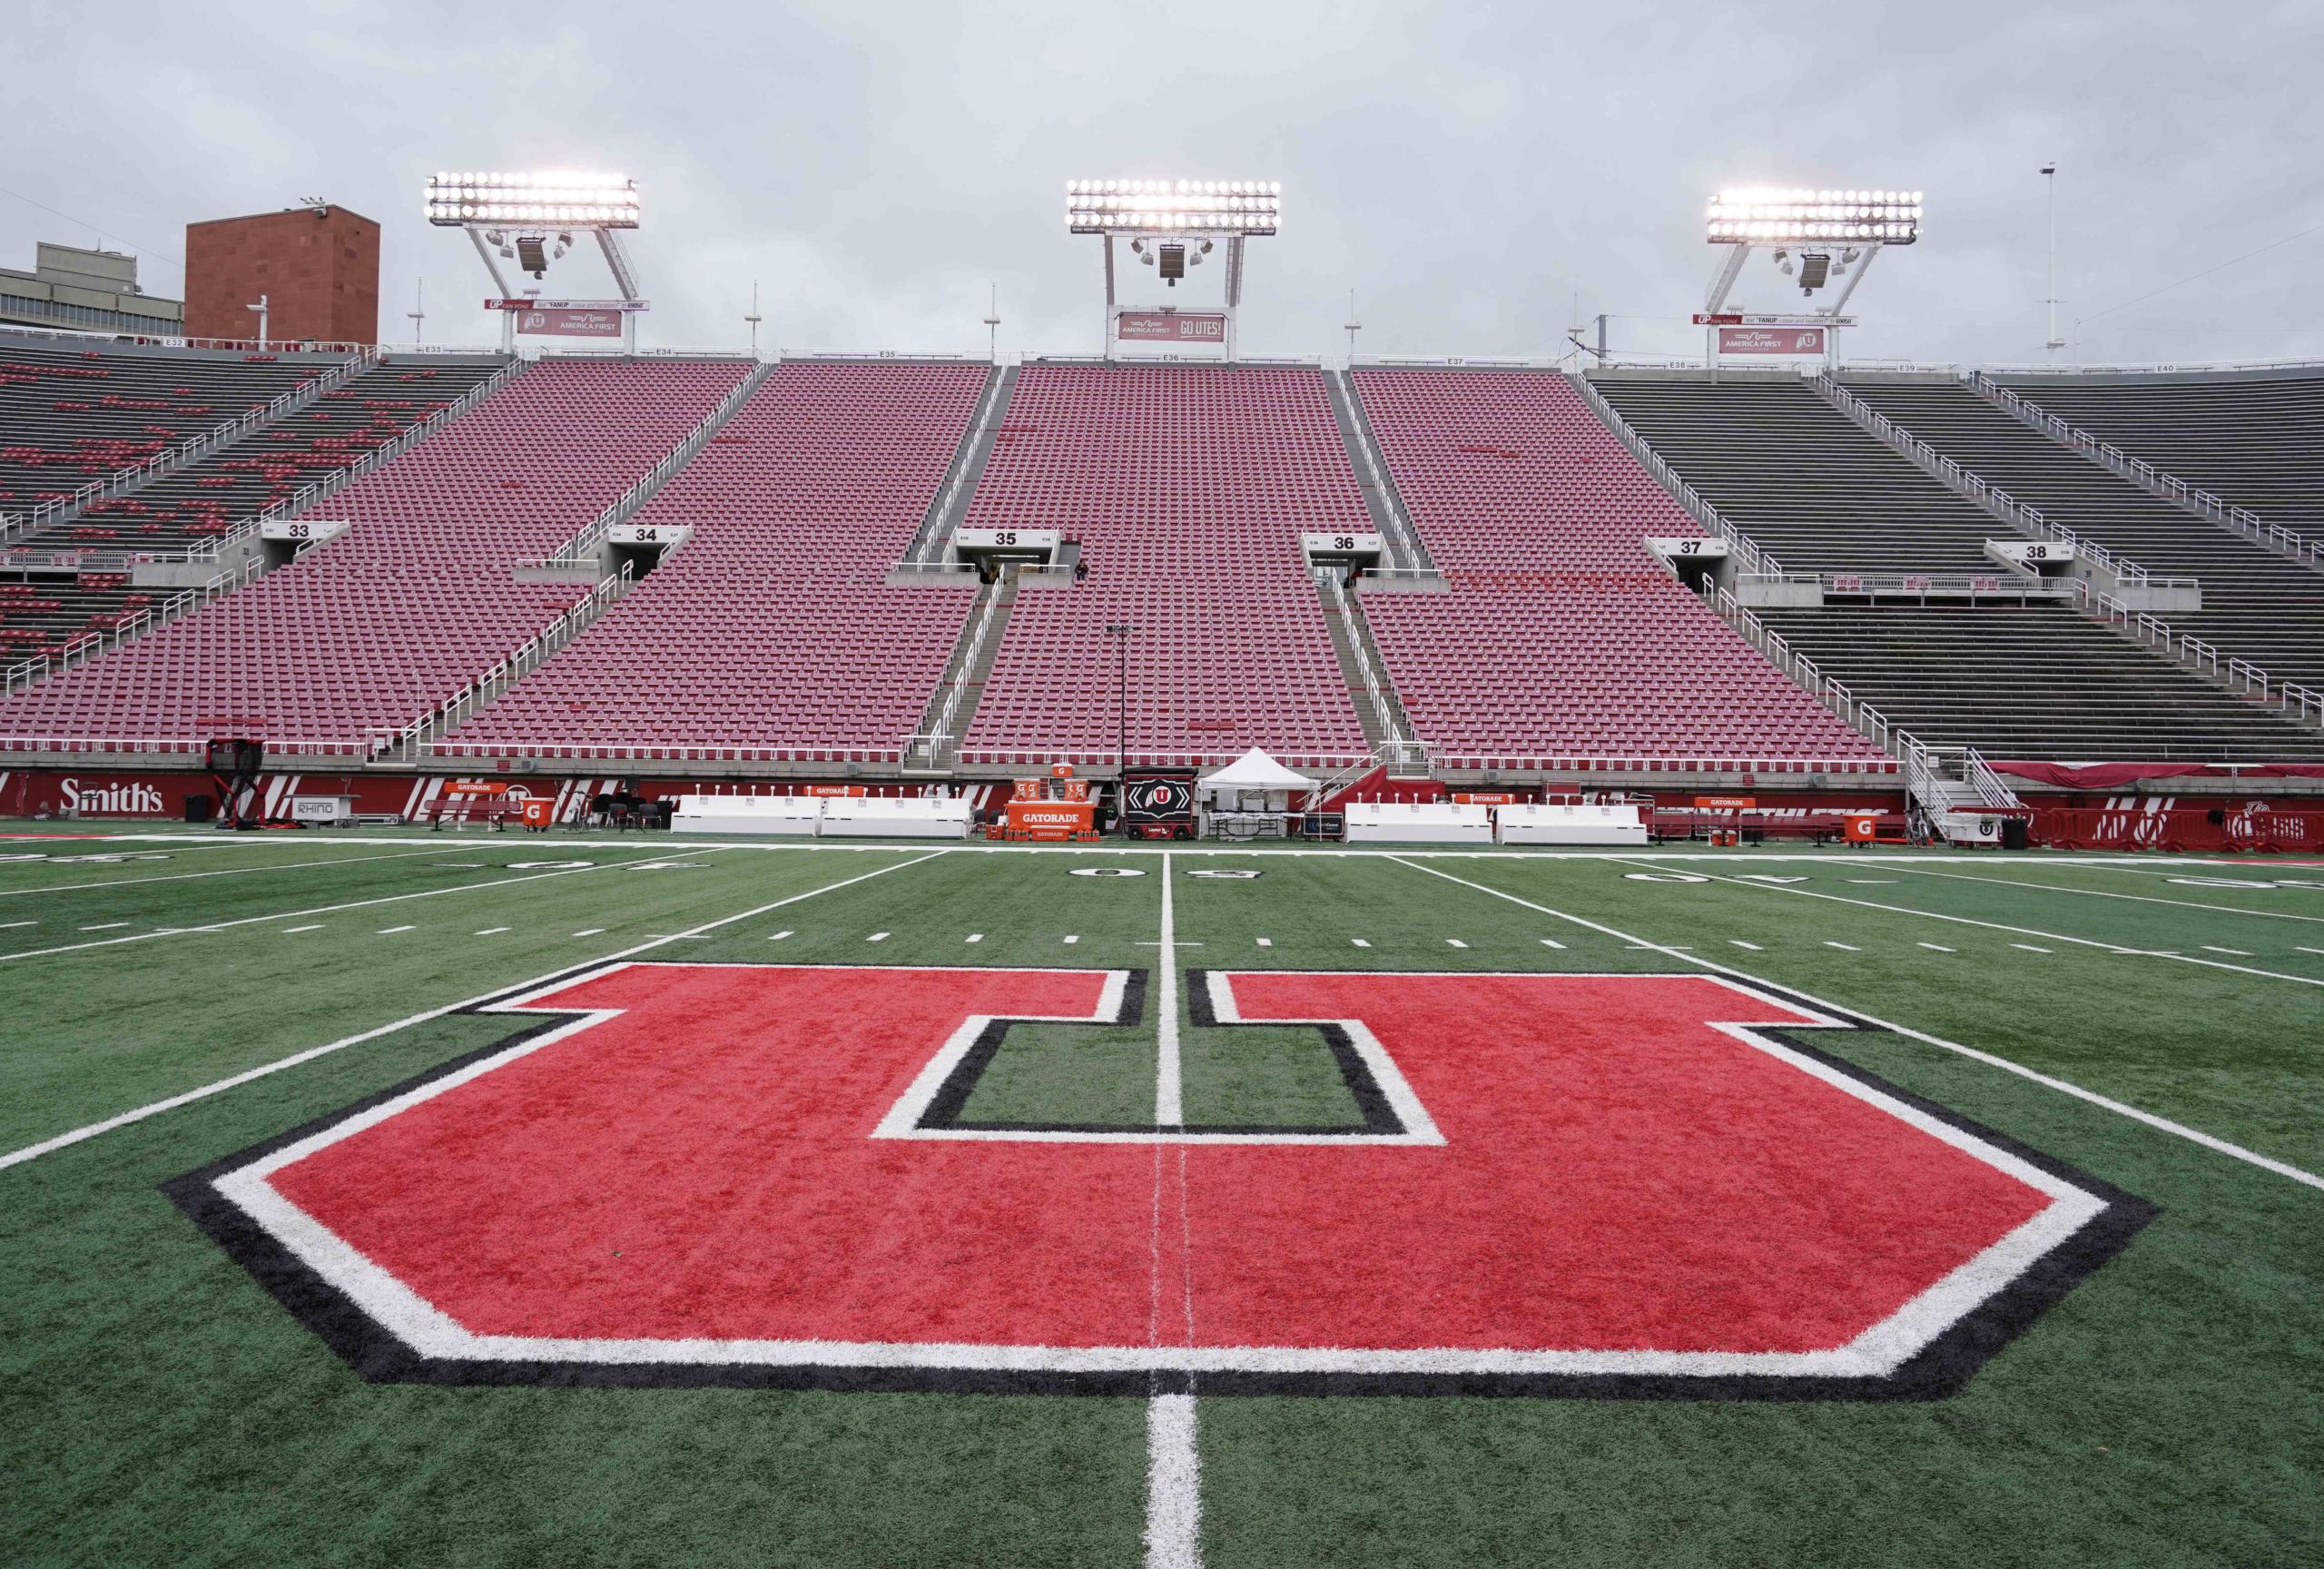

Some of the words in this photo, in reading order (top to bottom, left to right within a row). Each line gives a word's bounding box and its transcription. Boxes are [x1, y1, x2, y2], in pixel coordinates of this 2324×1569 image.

[1180, 321, 1194, 335] GO
[1196, 321, 1221, 336] UTES!
[289, 525, 309, 537] 33
[635, 528, 656, 541] 34
[995, 532, 1017, 546] 35
[1334, 537, 1354, 549] 36
[1680, 541, 1701, 554] 37
[2026, 546, 2047, 558] 38
[1018, 784, 1025, 792] G
[60, 777, 163, 813] Smith's
[1156, 789, 1169, 803] U
[298, 803, 333, 814] RHINO
[527, 804, 540, 819] G
[1022, 814, 1078, 823] GATORADE
[1858, 821, 1872, 834] G
[209, 959, 2115, 1380] U
